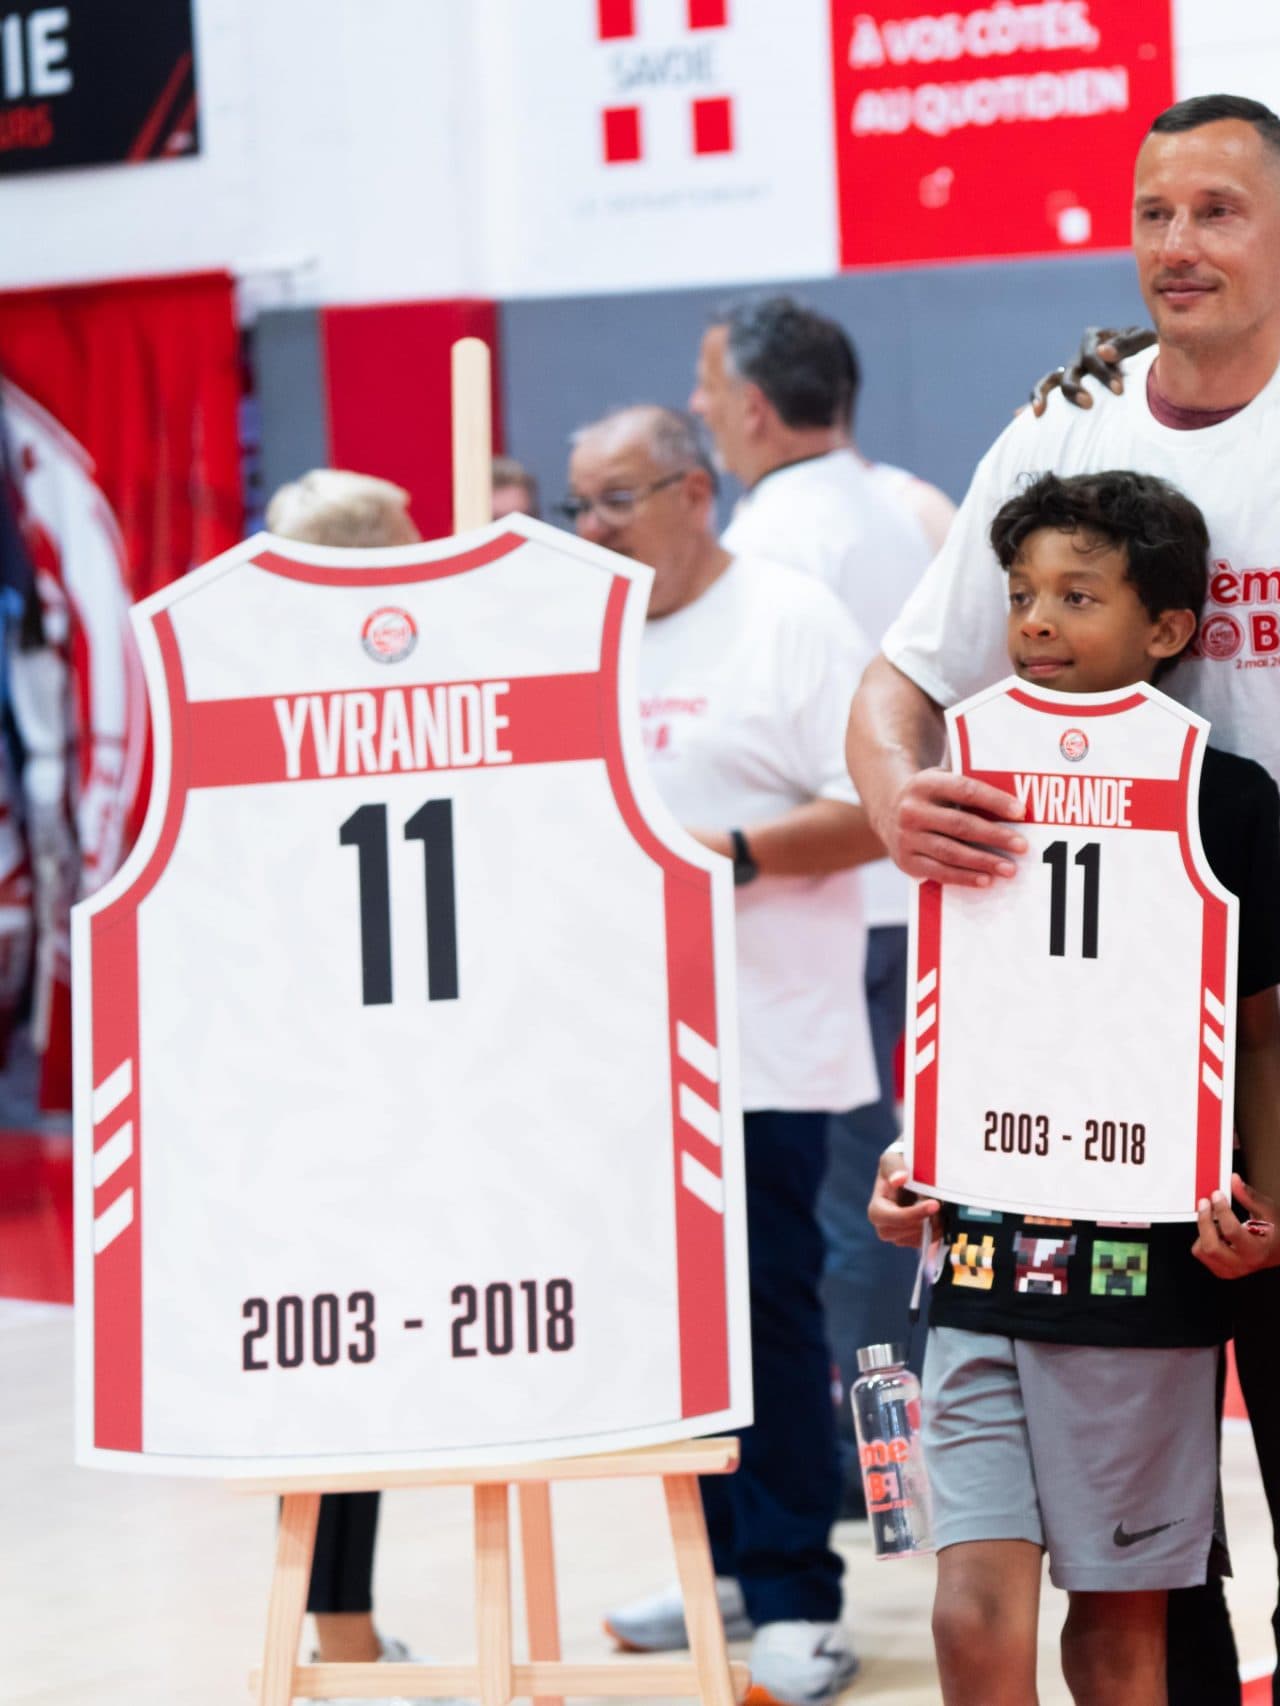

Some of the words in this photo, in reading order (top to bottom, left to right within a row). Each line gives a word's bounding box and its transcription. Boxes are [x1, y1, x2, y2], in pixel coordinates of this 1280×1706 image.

[0, 7, 72, 98] IE
[881, 13, 963, 65] VOS
[852, 87, 911, 136] AU
[912, 65, 1128, 136] QUOTIDIEN
[1244, 656, 1269, 668] mai
[273, 681, 513, 779] YVRANDE
[1013, 773, 1133, 827] YVRANDE
[339, 797, 459, 1006] 11
[1042, 840, 1101, 959] 11
[983, 1110, 1050, 1156] 2003
[1084, 1119, 1147, 1165] 2018
[242, 1291, 375, 1371] 2003
[450, 1278, 575, 1358] 2018
